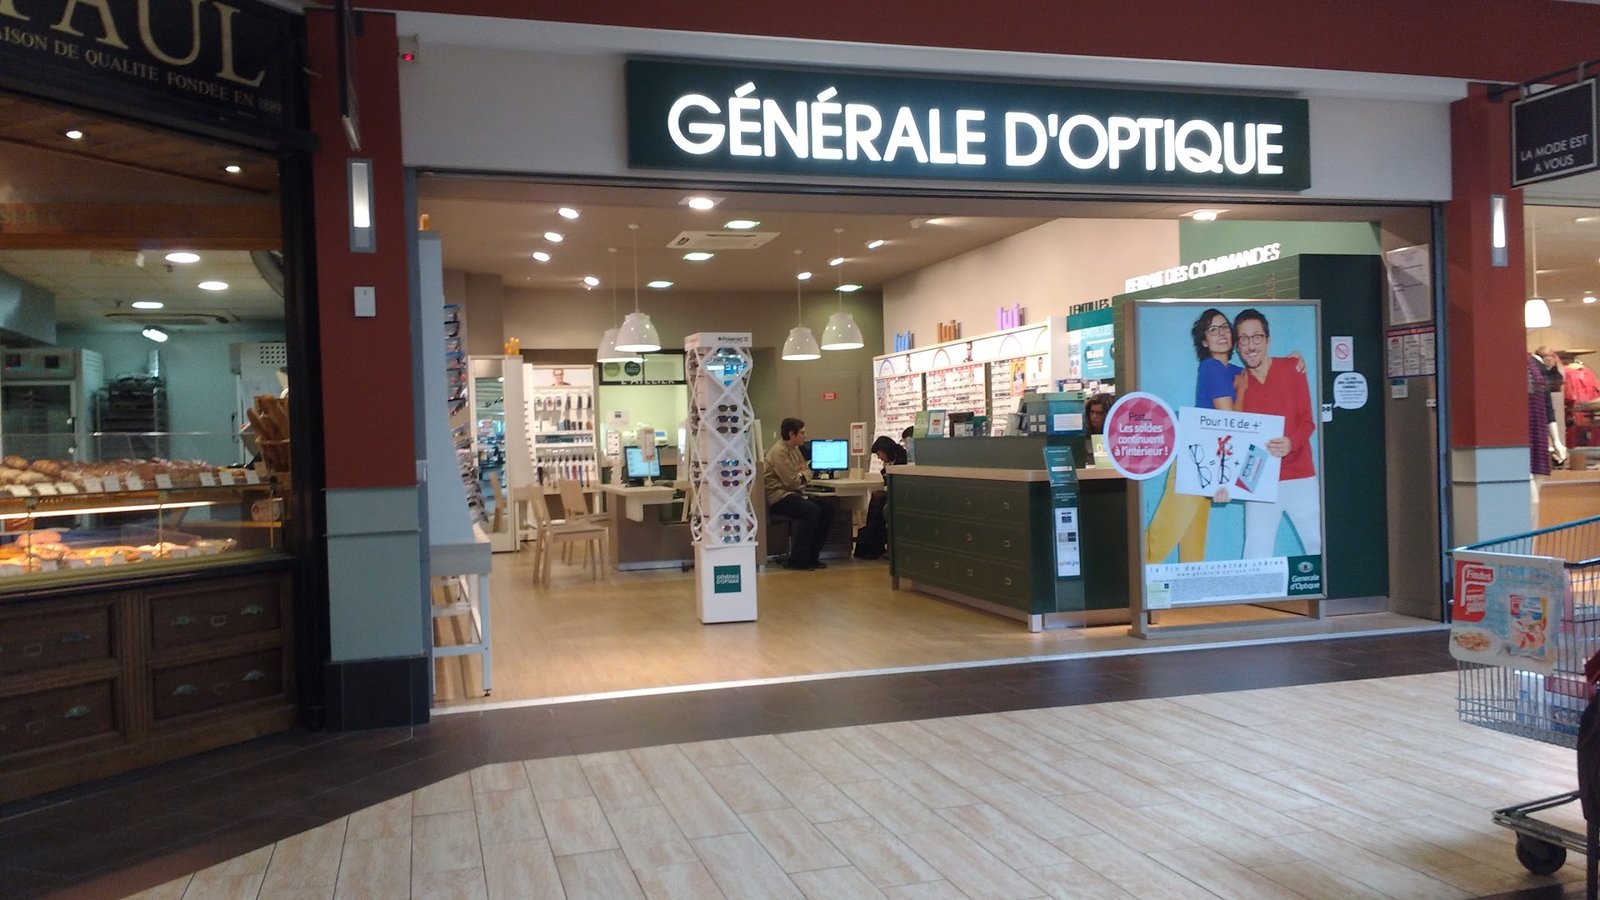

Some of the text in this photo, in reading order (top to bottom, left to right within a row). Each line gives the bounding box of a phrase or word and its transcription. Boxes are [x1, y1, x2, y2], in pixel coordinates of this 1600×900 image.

[0, 0, 265, 88] AUL
[0, 26, 48, 50] ISON
[53, 39, 80, 59] DE
[234, 90, 254, 107] EN
[667, 81, 1285, 176] GÉNÉRALE D'OPTIQUE
[1520, 134, 1588, 162] LA MODE EST
[1534, 154, 1574, 174] A VOUS
[1188, 243, 1280, 281] COMMANDES
[1119, 423, 1164, 433] Les soldes
[1200, 415, 1222, 427] Pour
[1237, 419, 1250, 429] de
[1114, 446, 1121, 456] à
[1121, 445, 1163, 456] l'intérieur
[1118, 434, 1165, 444] continuent
